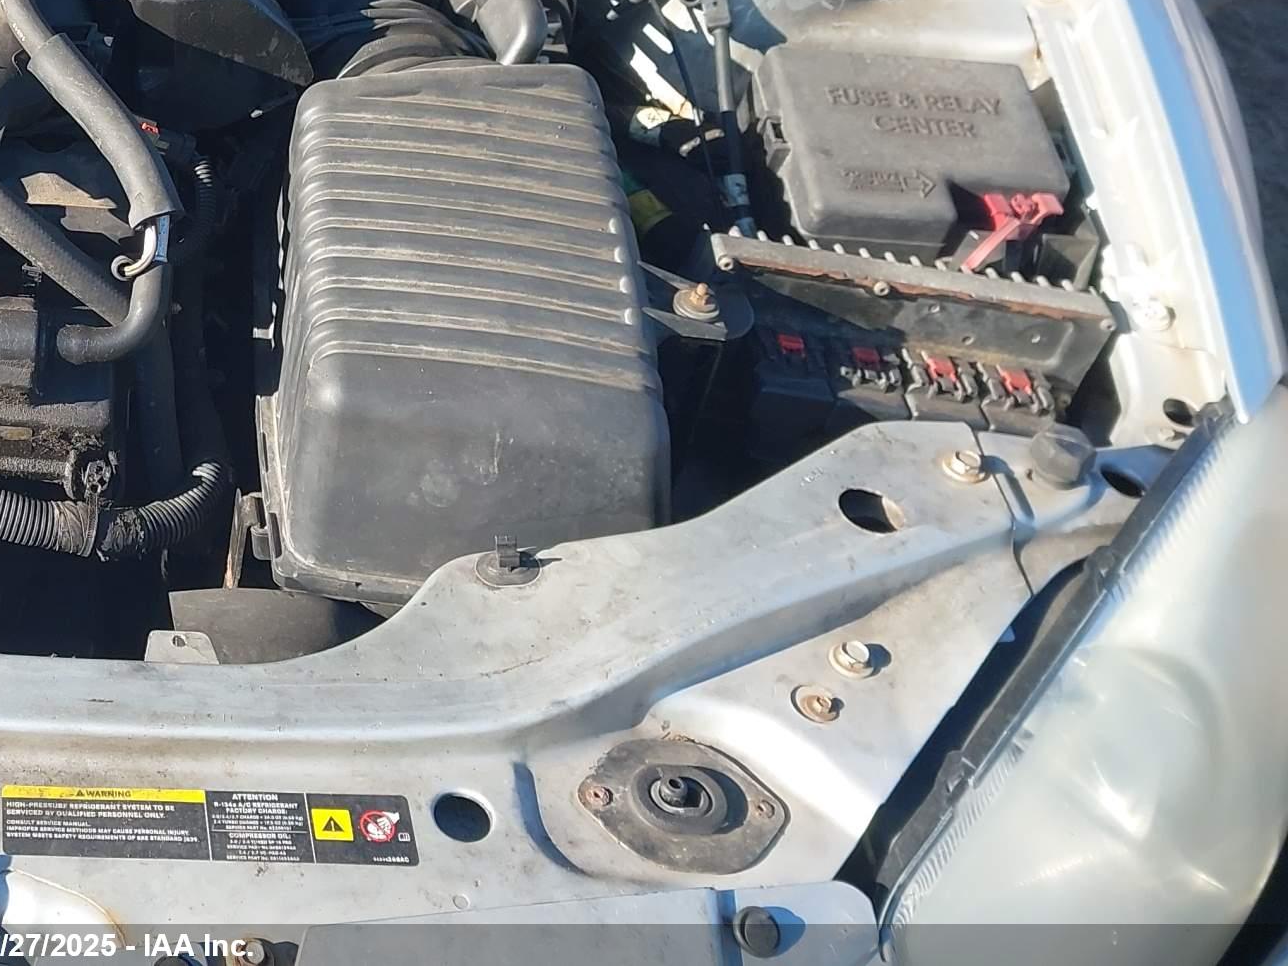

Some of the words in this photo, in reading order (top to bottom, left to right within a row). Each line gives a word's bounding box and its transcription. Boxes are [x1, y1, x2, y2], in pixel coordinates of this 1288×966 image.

[826, 87, 890, 107] FUSE
[922, 94, 1002, 115] RELAY
[874, 115, 976, 138] CENTER
[86, 789, 131, 798] WARNING
[232, 793, 278, 801] ATTENTION
[98, 811, 143, 819] PERSONNEL
